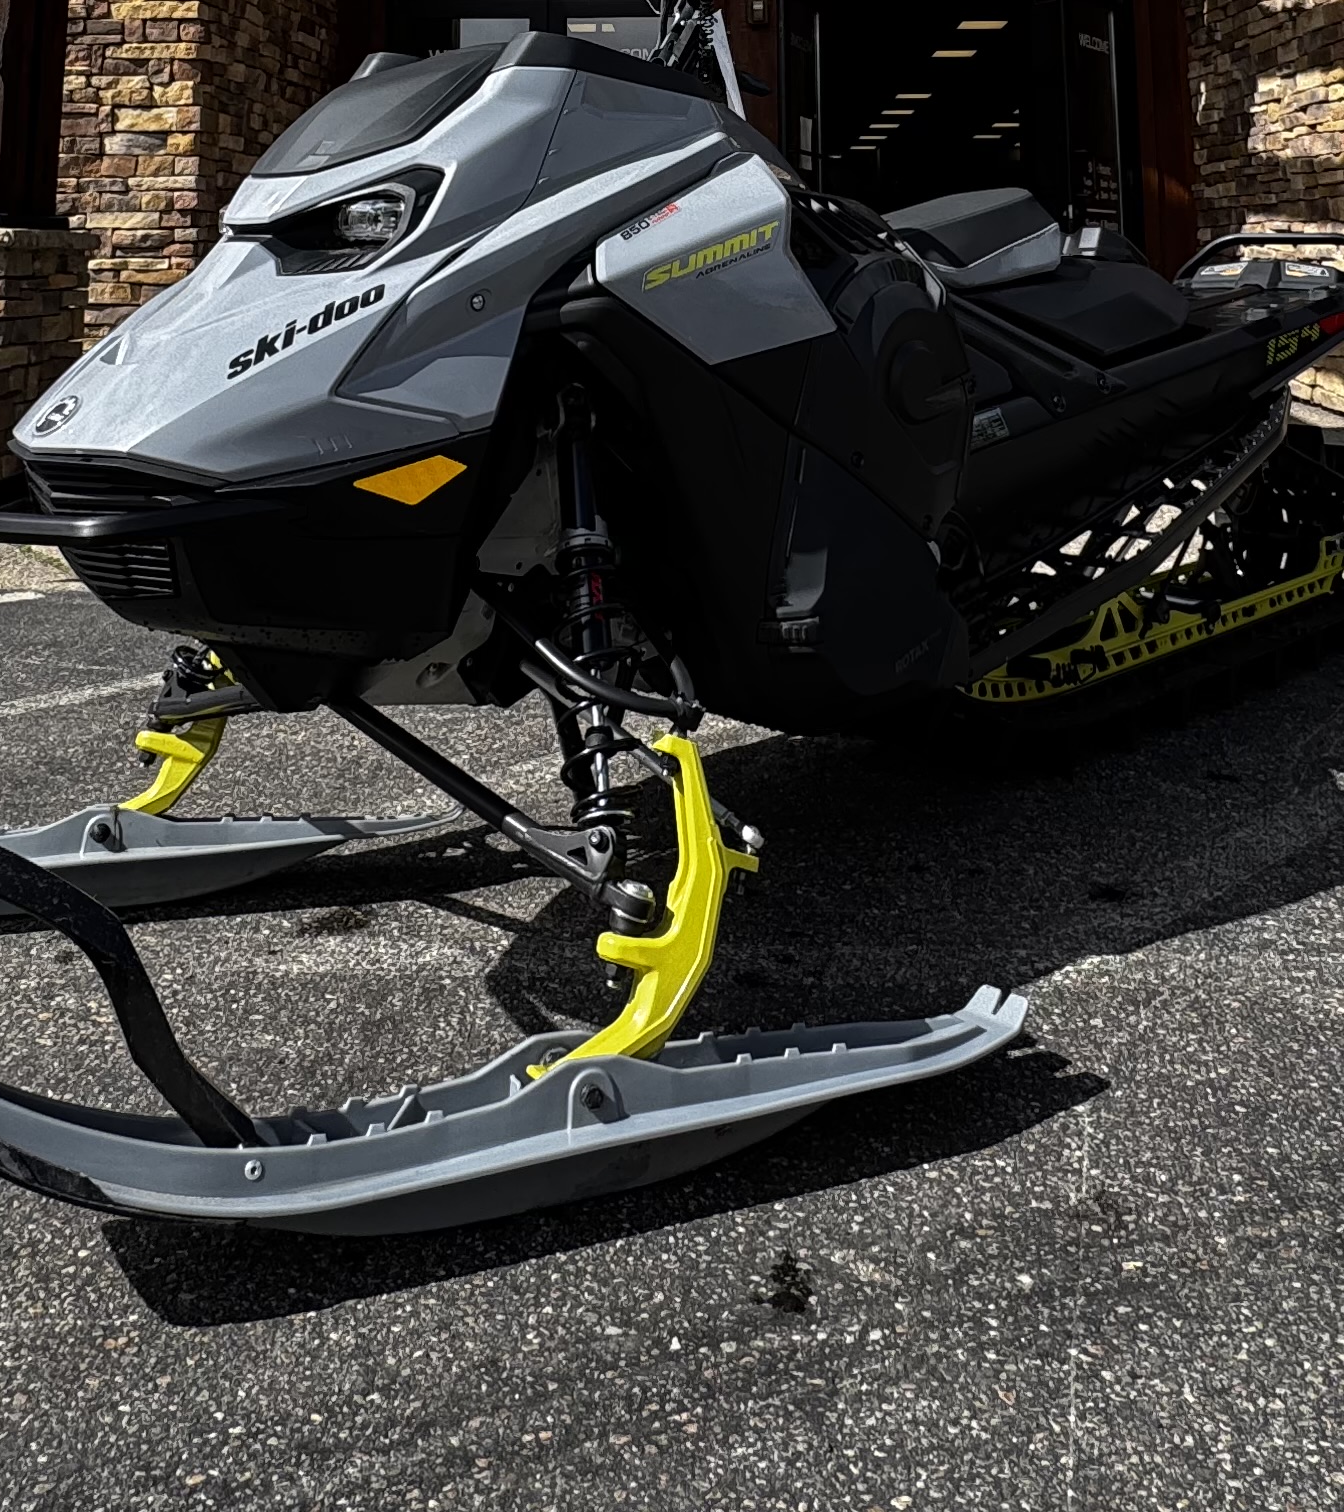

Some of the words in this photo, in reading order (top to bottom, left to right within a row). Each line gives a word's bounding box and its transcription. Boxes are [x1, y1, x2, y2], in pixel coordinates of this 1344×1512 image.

[620, 220, 650, 240] 850
[645, 220, 780, 290] SUMMIT
[696, 243, 771, 279] ADRENALINE
[227, 283, 385, 380] ski-doo
